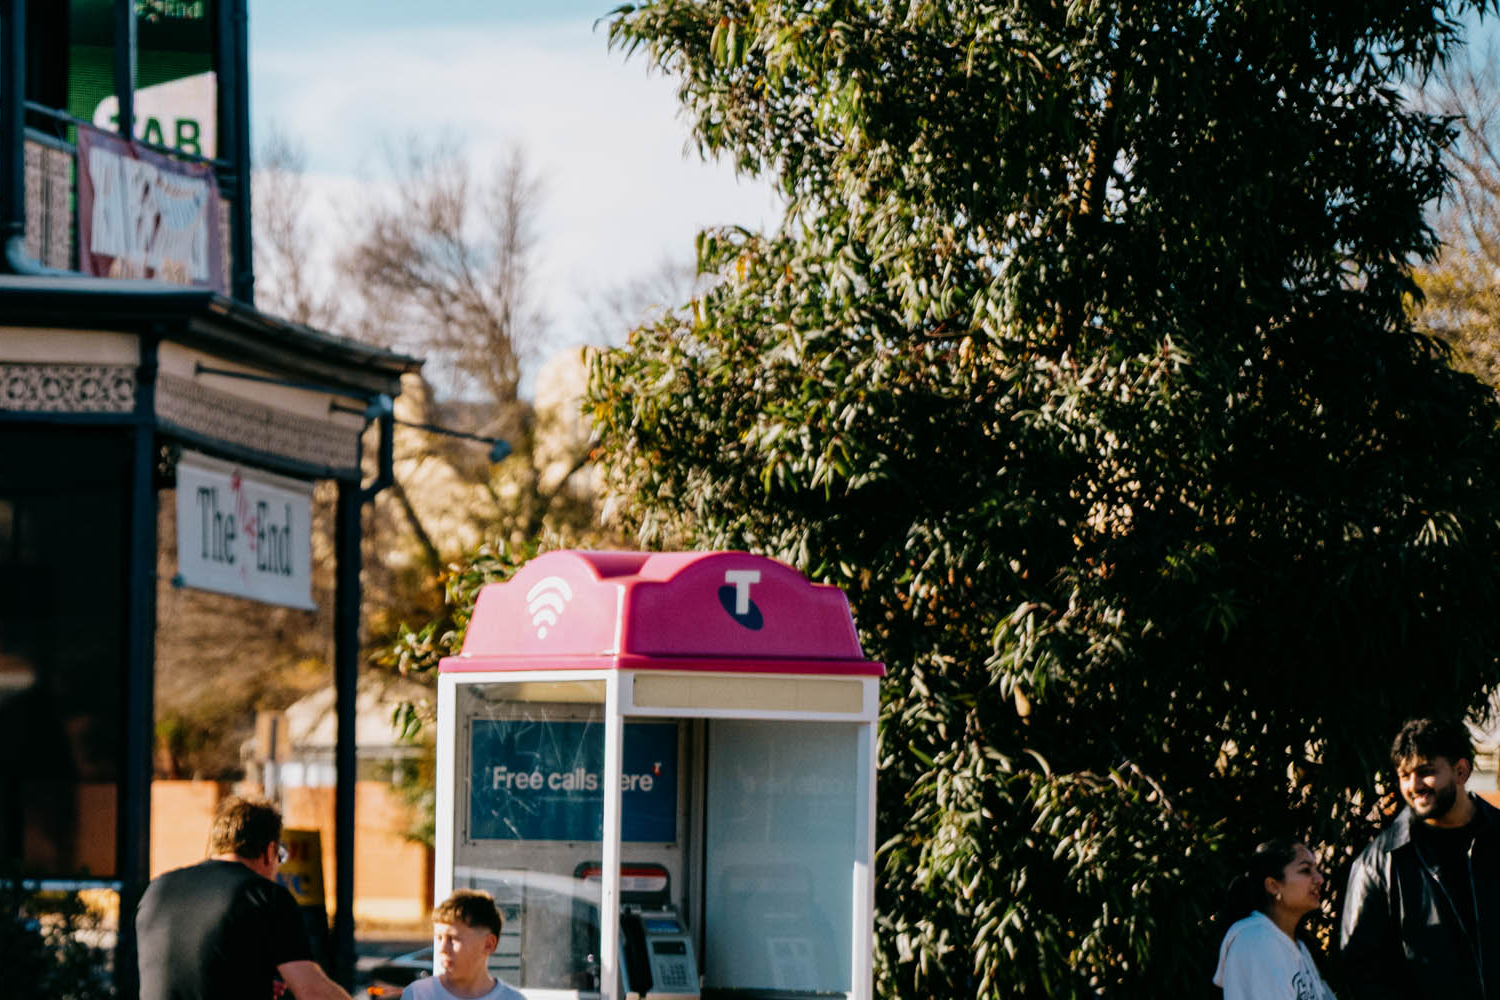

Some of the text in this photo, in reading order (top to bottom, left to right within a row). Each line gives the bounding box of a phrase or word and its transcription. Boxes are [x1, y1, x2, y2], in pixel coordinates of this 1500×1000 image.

[109, 116, 202, 160] AB
[197, 486, 292, 576] The End
[725, 570, 761, 614] T
[492, 766, 654, 791] Free calls ere
